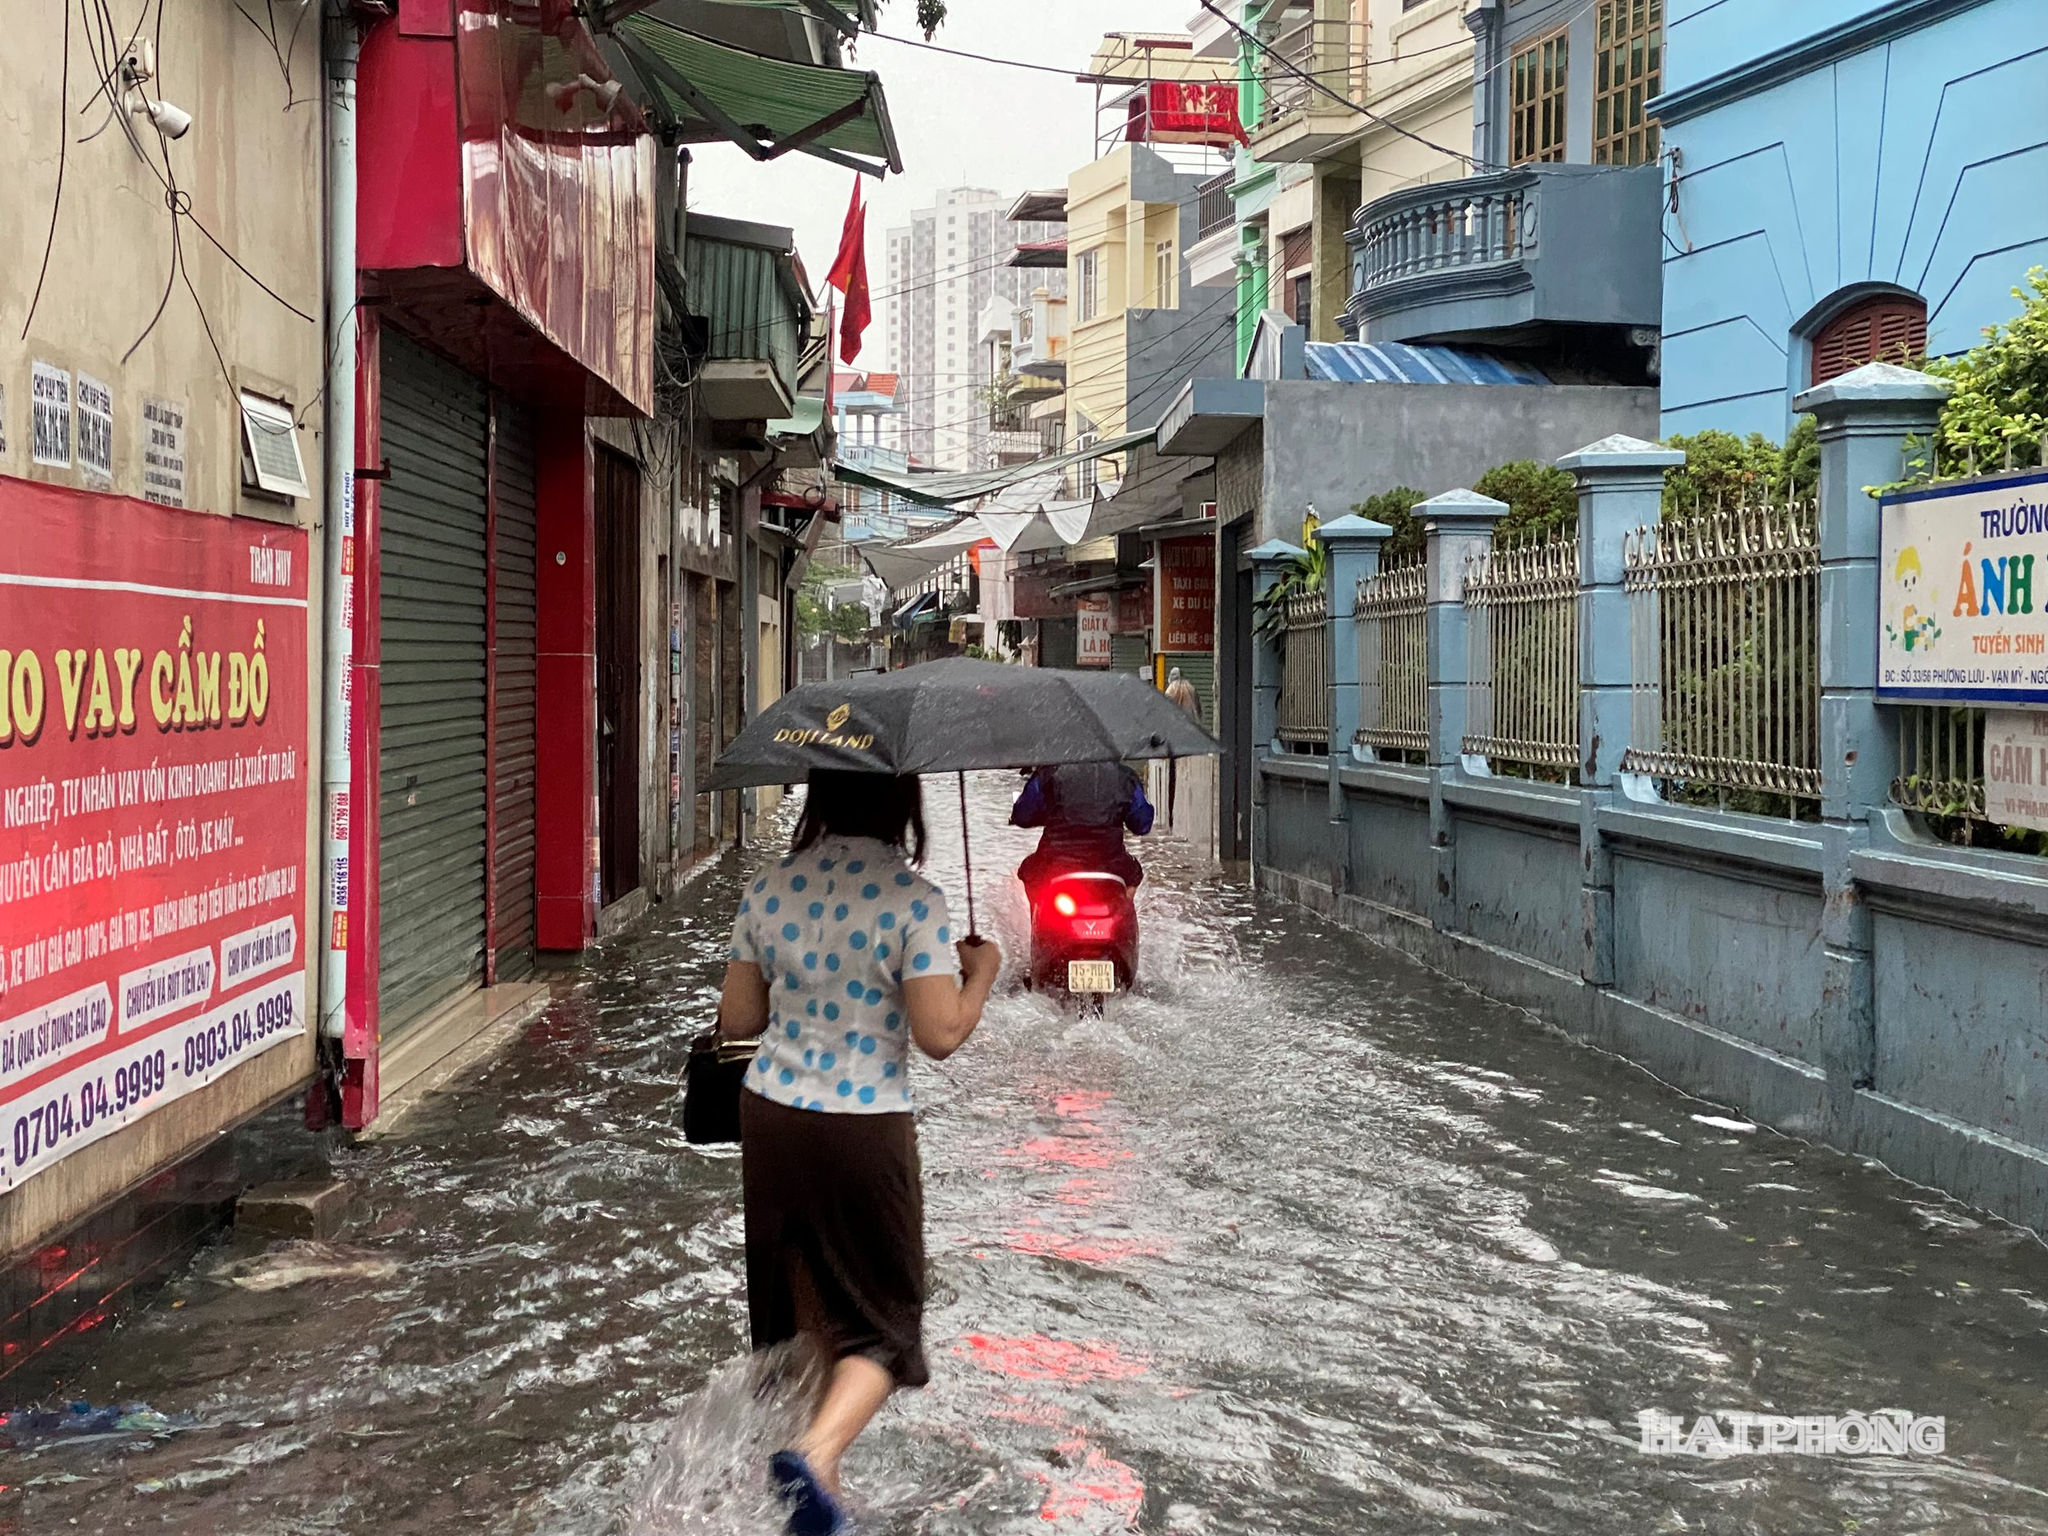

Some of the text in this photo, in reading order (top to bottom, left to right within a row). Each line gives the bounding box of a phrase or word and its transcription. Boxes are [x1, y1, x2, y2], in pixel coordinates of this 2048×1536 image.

[275, 549, 291, 587] HUY
[1173, 577, 1191, 590] TAXI
[1953, 541, 2035, 617] ÁNH
[1173, 596, 1184, 610] XE
[1188, 596, 1200, 609] DU
[55, 648, 141, 739] VAY
[150, 615, 221, 732] CẦM
[228, 618, 269, 727] ĐỒ
[1933, 668, 1966, 683] PHƯƠNG
[2015, 633, 2045, 655] SINH
[5, 775, 58, 830] NGHIỆP,
[82, 766, 116, 814] NHÂN
[118, 769, 141, 806] VAY
[142, 756, 165, 803] VỐN
[168, 763, 193, 800] KINH
[195, 759, 227, 796] DOANH
[244, 745, 268, 788] XUẤT
[1990, 734, 2032, 785] CẤM
[72, 836, 94, 886] BÌA
[120, 825, 144, 872] NHÀ
[146, 818, 168, 866] ĐẤT
[200, 821, 212, 854] XE
[10, 946, 23, 988] XE
[25, 932, 46, 983] MÁY
[48, 925, 63, 974] GIÁ
[65, 927, 82, 968] CAO
[110, 906, 124, 952] GIÁ
[18, 1028, 34, 1070] QUA
[90, 998, 106, 1034] CAO
[14, 1048, 165, 1167] 0704.04.9999
[184, 989, 293, 1078] 0903.04.9999
